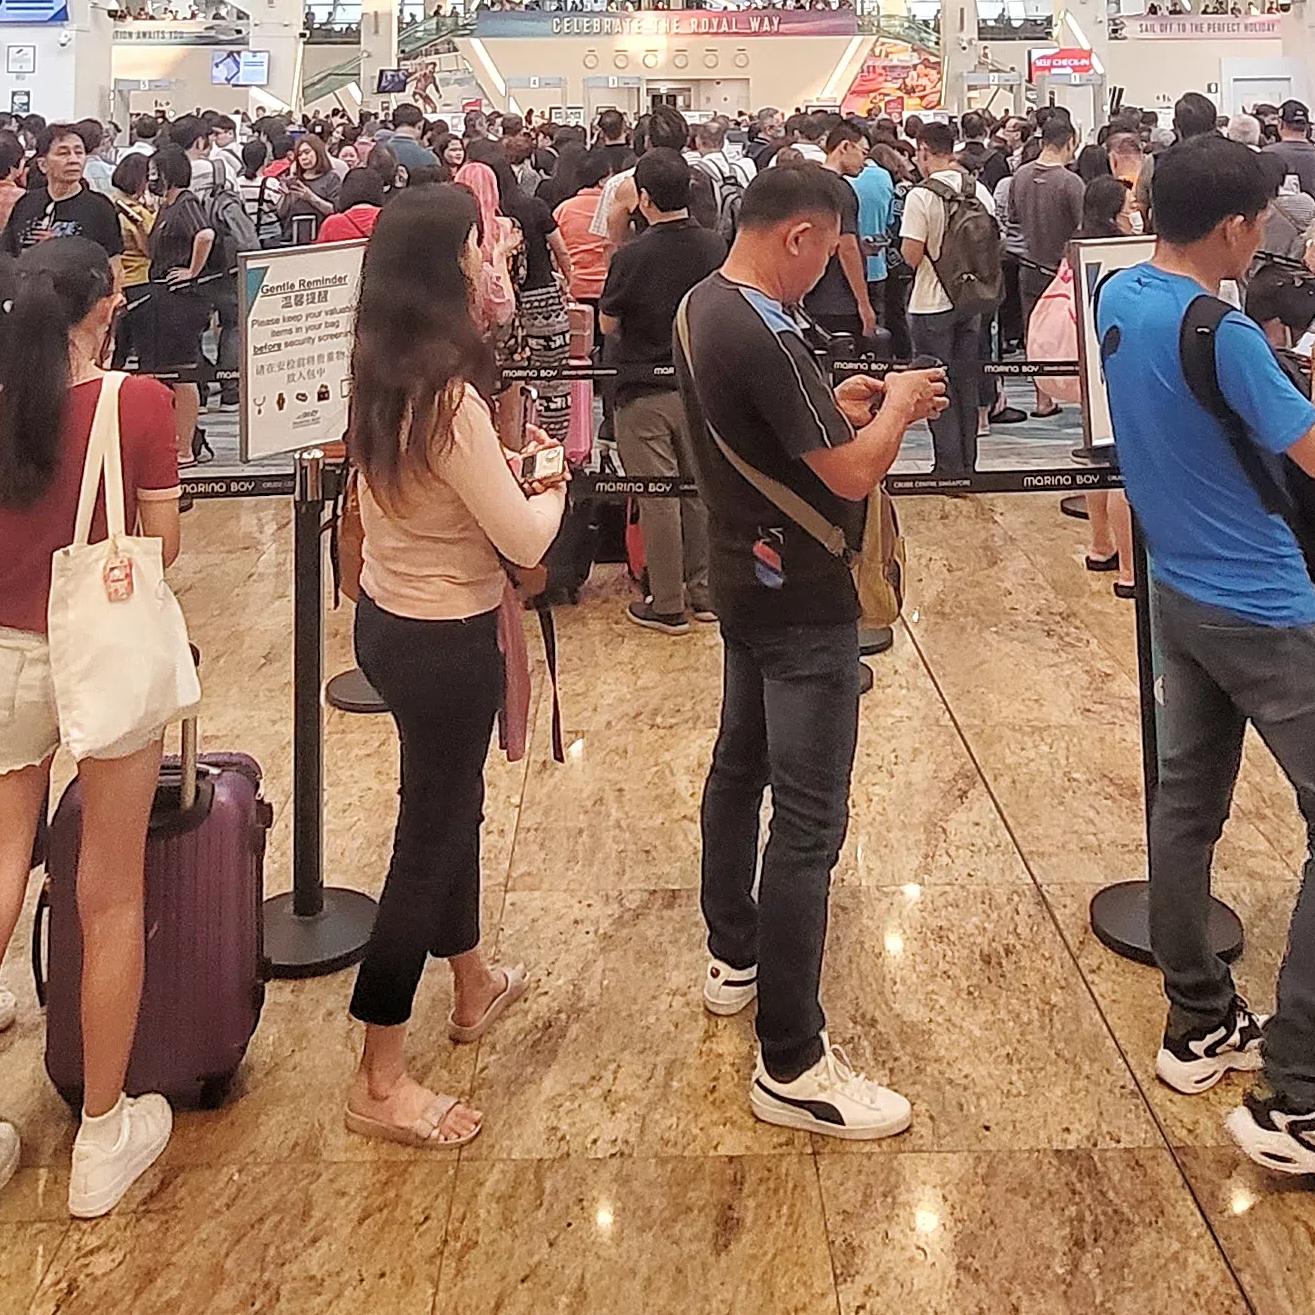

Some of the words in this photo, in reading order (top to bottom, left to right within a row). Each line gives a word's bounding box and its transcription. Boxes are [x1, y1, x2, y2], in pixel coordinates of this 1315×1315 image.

[552, 16, 645, 34] CELEBRATE
[655, 16, 680, 33] THE
[690, 16, 737, 32] ROYAL
[749, 16, 782, 32] WAY
[1139, 23, 1157, 33] SAIL
[1160, 23, 1173, 33] OFF
[1177, 23, 1186, 33] TO
[1190, 23, 1204, 33] THE
[1207, 22, 1241, 33] PERFECT
[1244, 22, 1275, 32] HOLIDAY
[136, 30, 165, 39] AWAITS
[261, 281, 296, 295] Gentle
[298, 274, 348, 289] Reminder
[252, 317, 281, 328] Please
[282, 315, 303, 324] keep
[305, 310, 323, 321] your
[271, 327, 293, 337] items
[305, 323, 323, 333] your
[324, 320, 340, 329] bag
[253, 342, 282, 355] before
[284, 336, 316, 348] security
[653, 367, 674, 375] MAR
[230, 481, 255, 492] BAY
[1024, 475, 1072, 487] MARINA
[1076, 474, 1100, 484] BAY
[596, 482, 644, 493] MARINA
[648, 482, 672, 492] BAY
